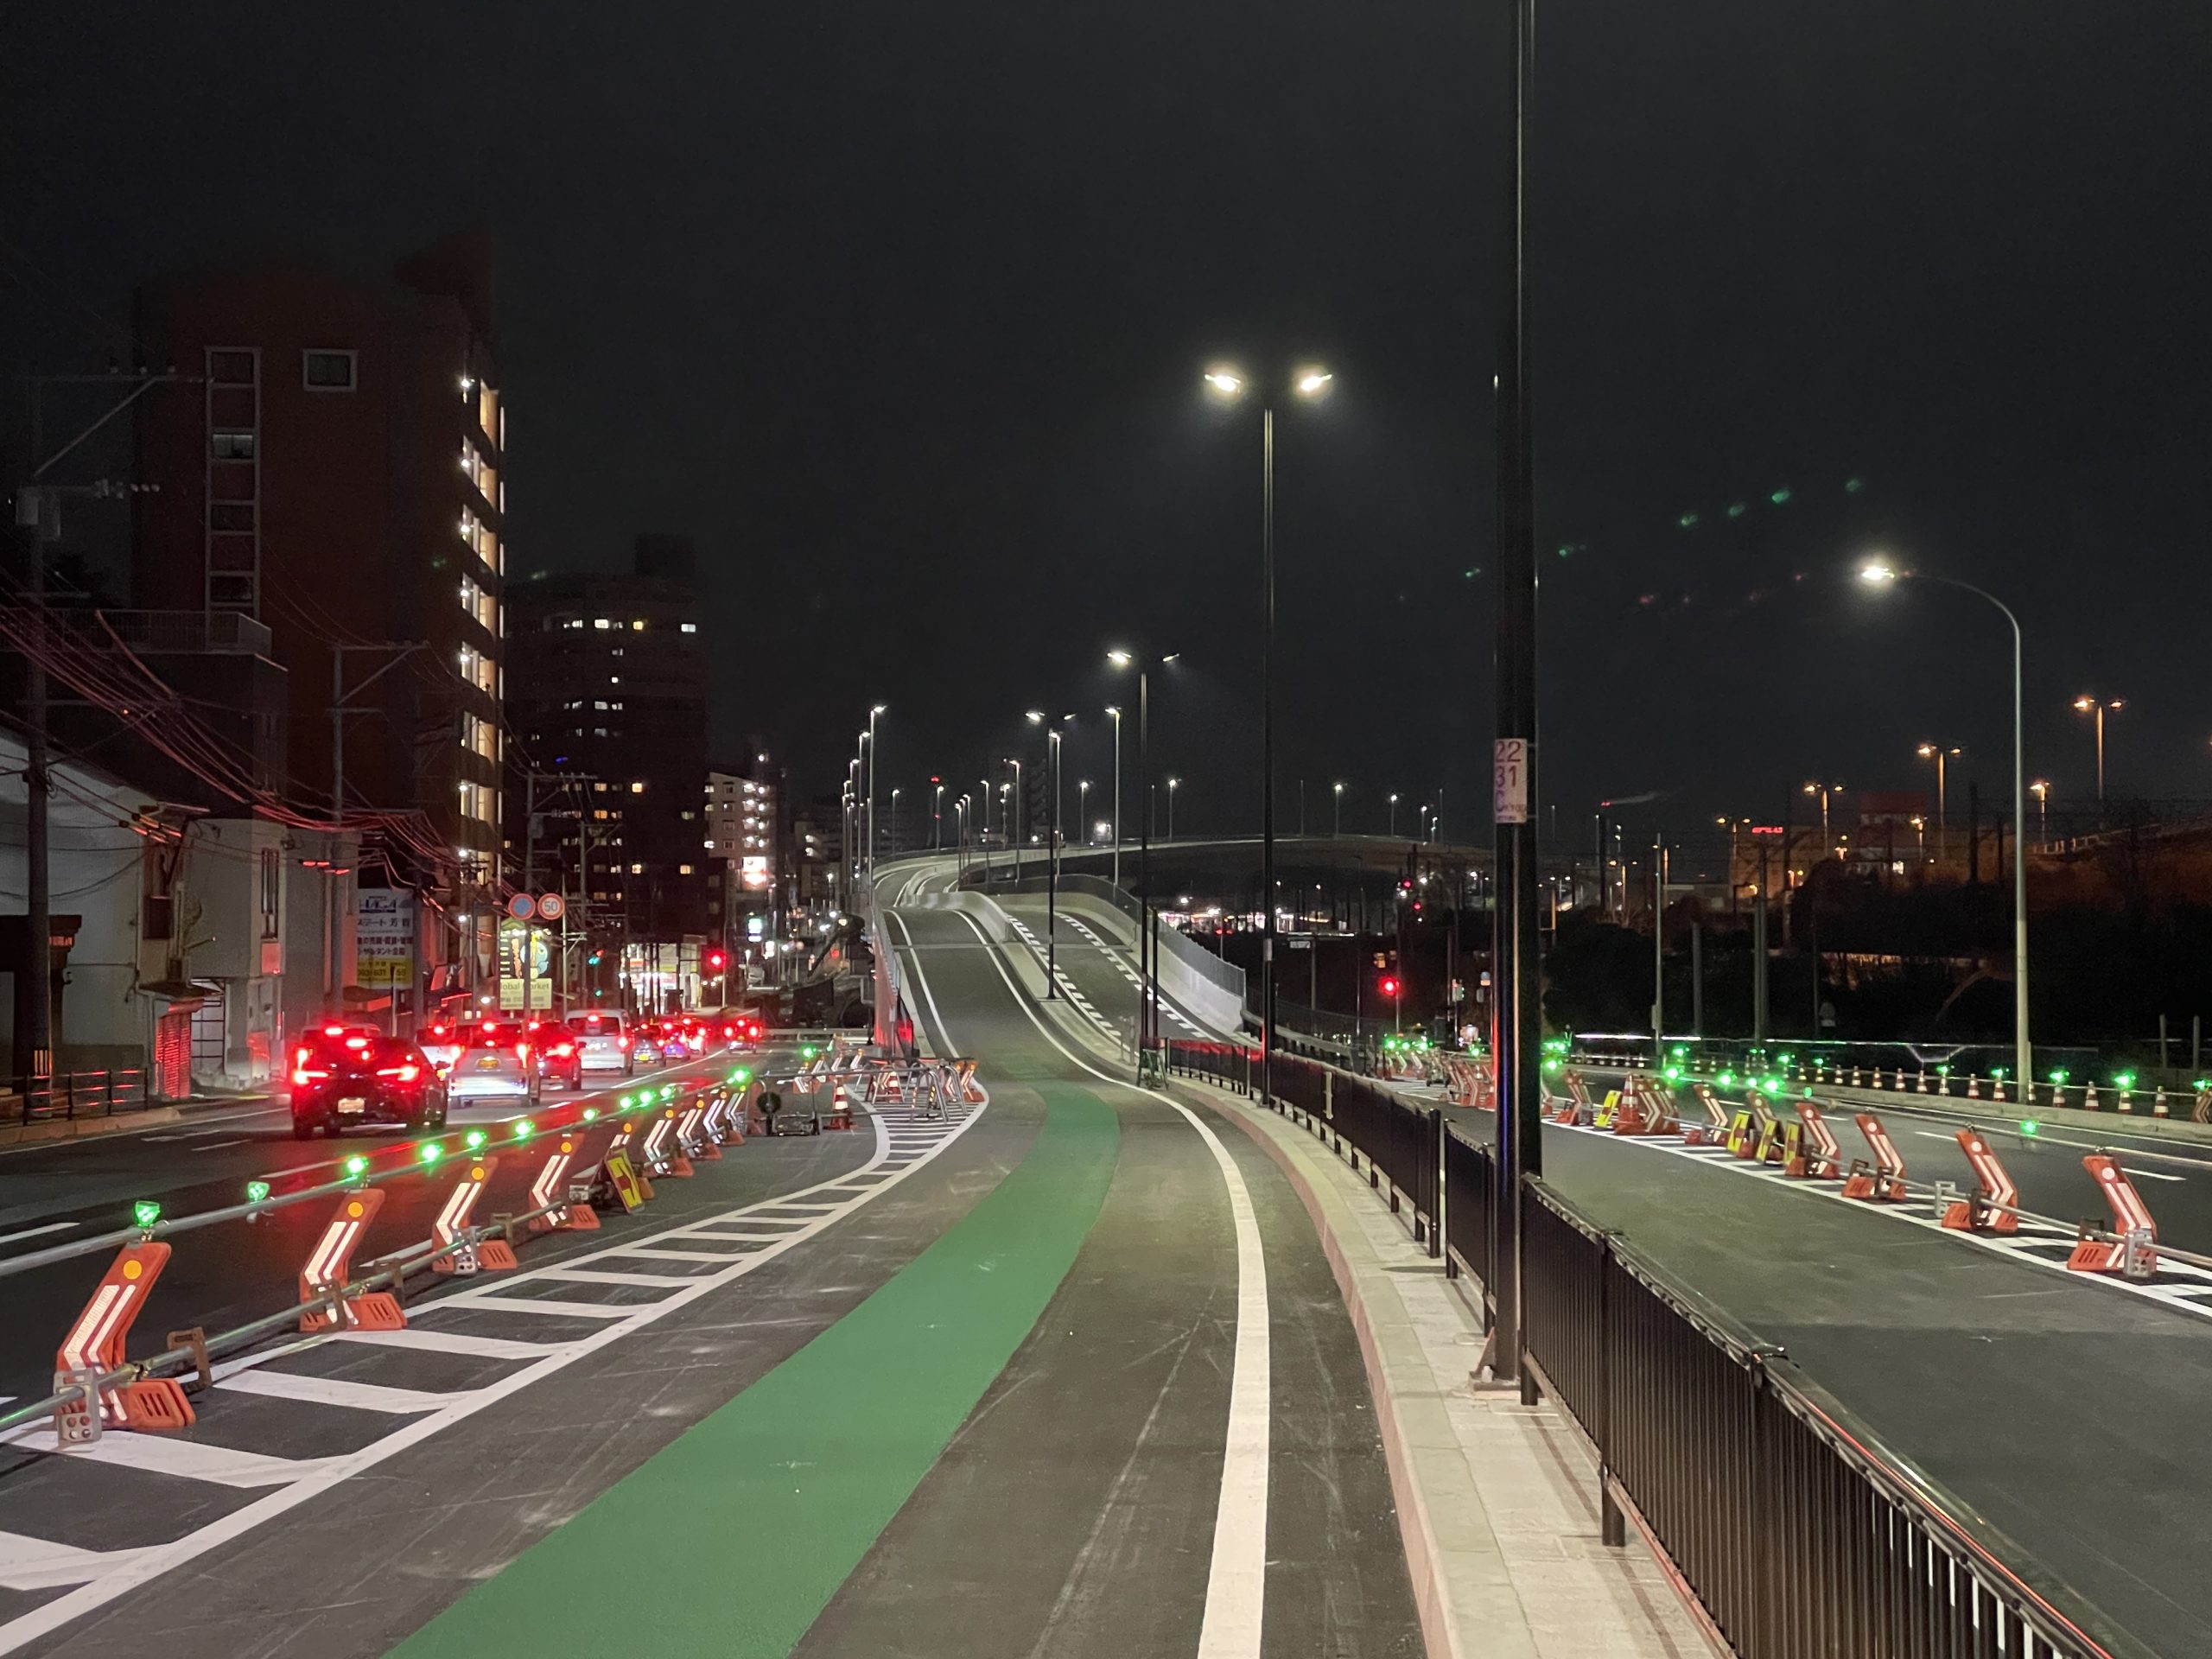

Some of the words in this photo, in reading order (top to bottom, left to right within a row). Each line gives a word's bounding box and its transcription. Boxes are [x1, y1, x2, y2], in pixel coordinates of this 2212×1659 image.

[1496, 741, 1521, 762] 22
[1496, 766, 1516, 788] 31
[544, 901, 558, 912] 50
